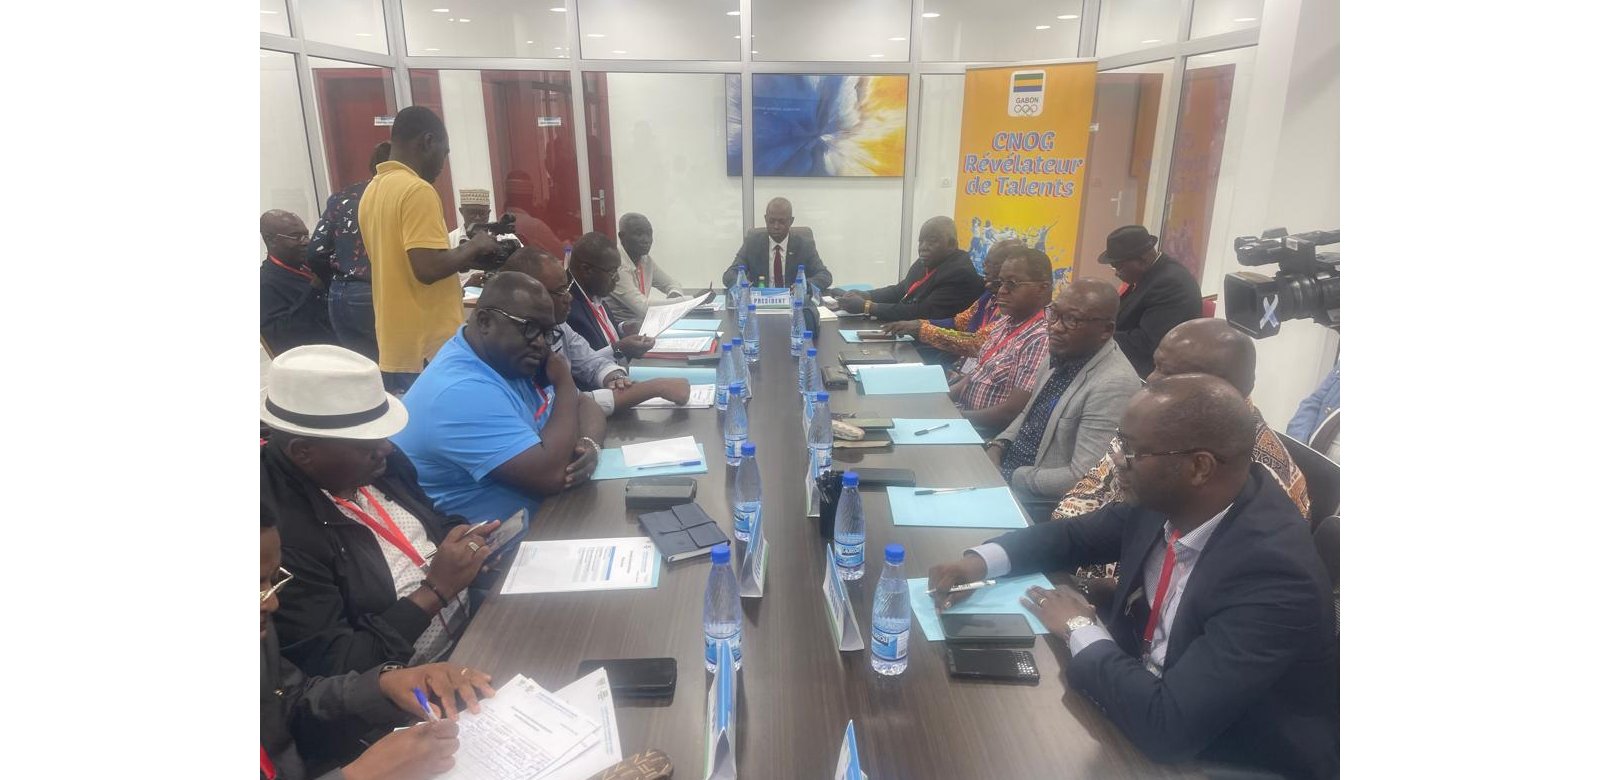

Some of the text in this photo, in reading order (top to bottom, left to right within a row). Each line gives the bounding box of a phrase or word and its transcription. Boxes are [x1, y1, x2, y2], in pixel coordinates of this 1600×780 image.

[1015, 96, 1039, 104] GABON
[992, 131, 1056, 151] CNOG
[964, 152, 1083, 175] Révélateur
[966, 176, 1075, 197] de Talents
